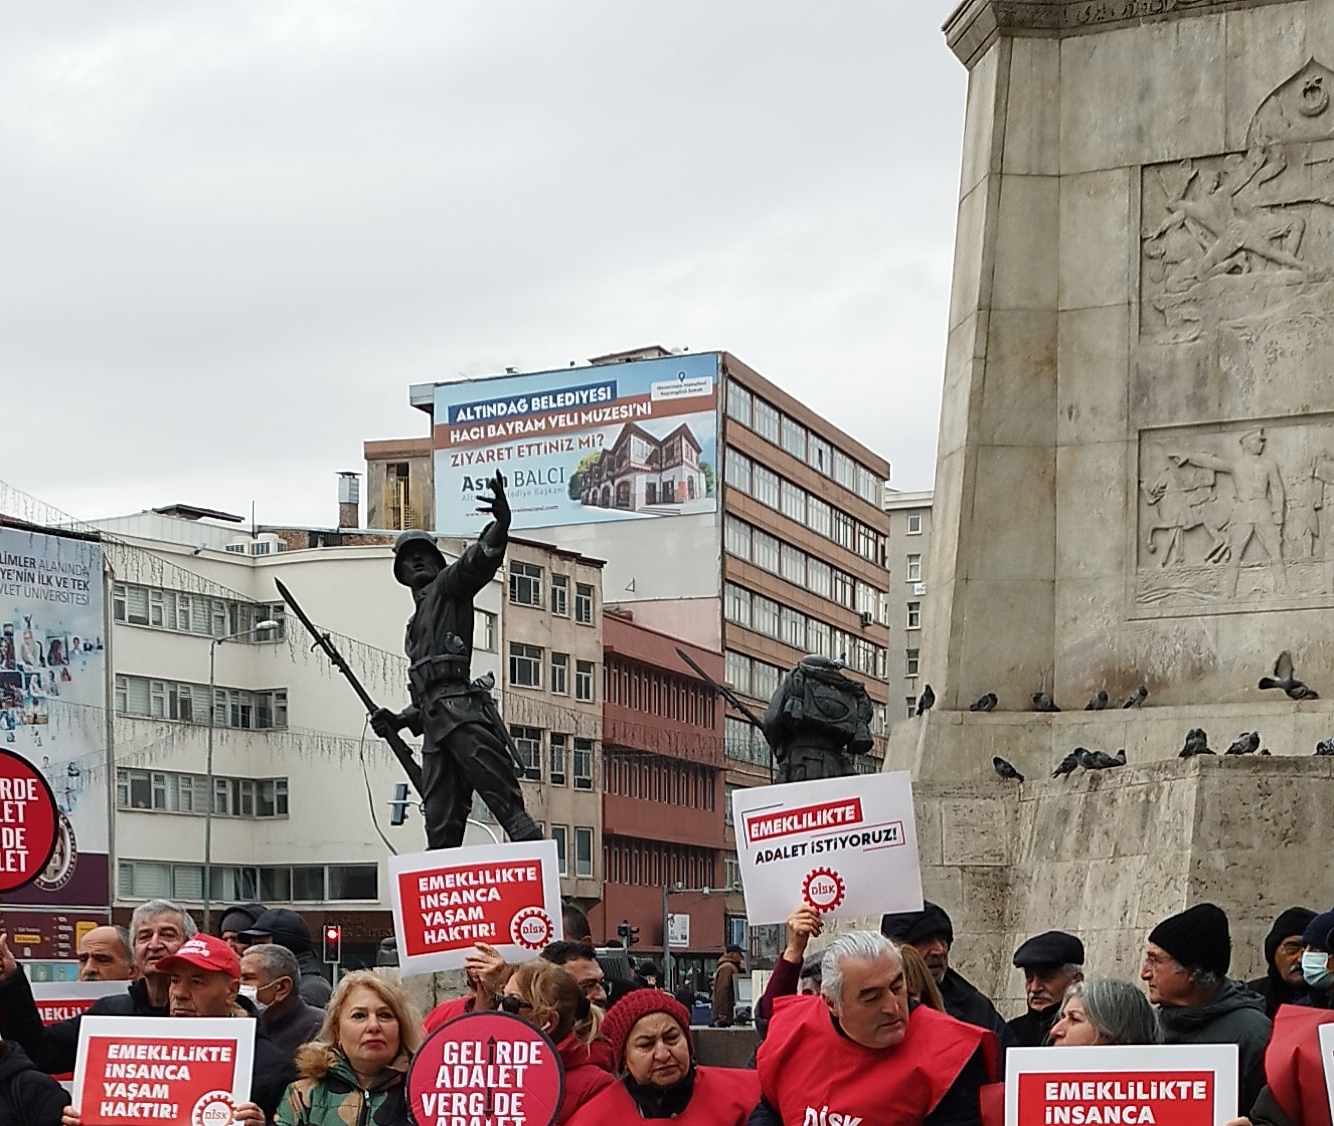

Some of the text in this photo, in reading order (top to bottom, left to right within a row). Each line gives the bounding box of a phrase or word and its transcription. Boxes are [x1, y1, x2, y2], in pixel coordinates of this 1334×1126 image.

[450, 426, 484, 443] HACI
[487, 417, 546, 439] BAYRAM
[451, 433, 605, 468] ZİYARET ETTİNİZ Mİ?
[514, 467, 564, 487] BALCI
[38, 557, 90, 577] ALANINDA
[37, 570, 53, 587] İLK
[55, 575, 69, 588] VE
[70, 577, 90, 592] TEK
[755, 827, 898, 865] ADALET İSTİYORUZ!
[418, 867, 538, 892] EMEKLİLİKTE
[811, 881, 836, 896] DİSK
[419, 887, 501, 910] İNSANCA
[421, 906, 485, 926] YAŞAM
[423, 922, 496, 945] HAKTIR!
[522, 923, 545, 935] DİSK
[107, 1044, 232, 1063] EMEKLİLİKTE
[104, 1063, 191, 1081] İNSANCA
[435, 1065, 528, 1088] ADALET
[103, 1082, 170, 1102] YAŞAM
[1045, 1081, 1207, 1101] EMEKLİLİKTE
[100, 1102, 178, 1119] HAKTIR!
[204, 1105, 228, 1120] DİSK
[1045, 1105, 1156, 1125] İNSANCA
